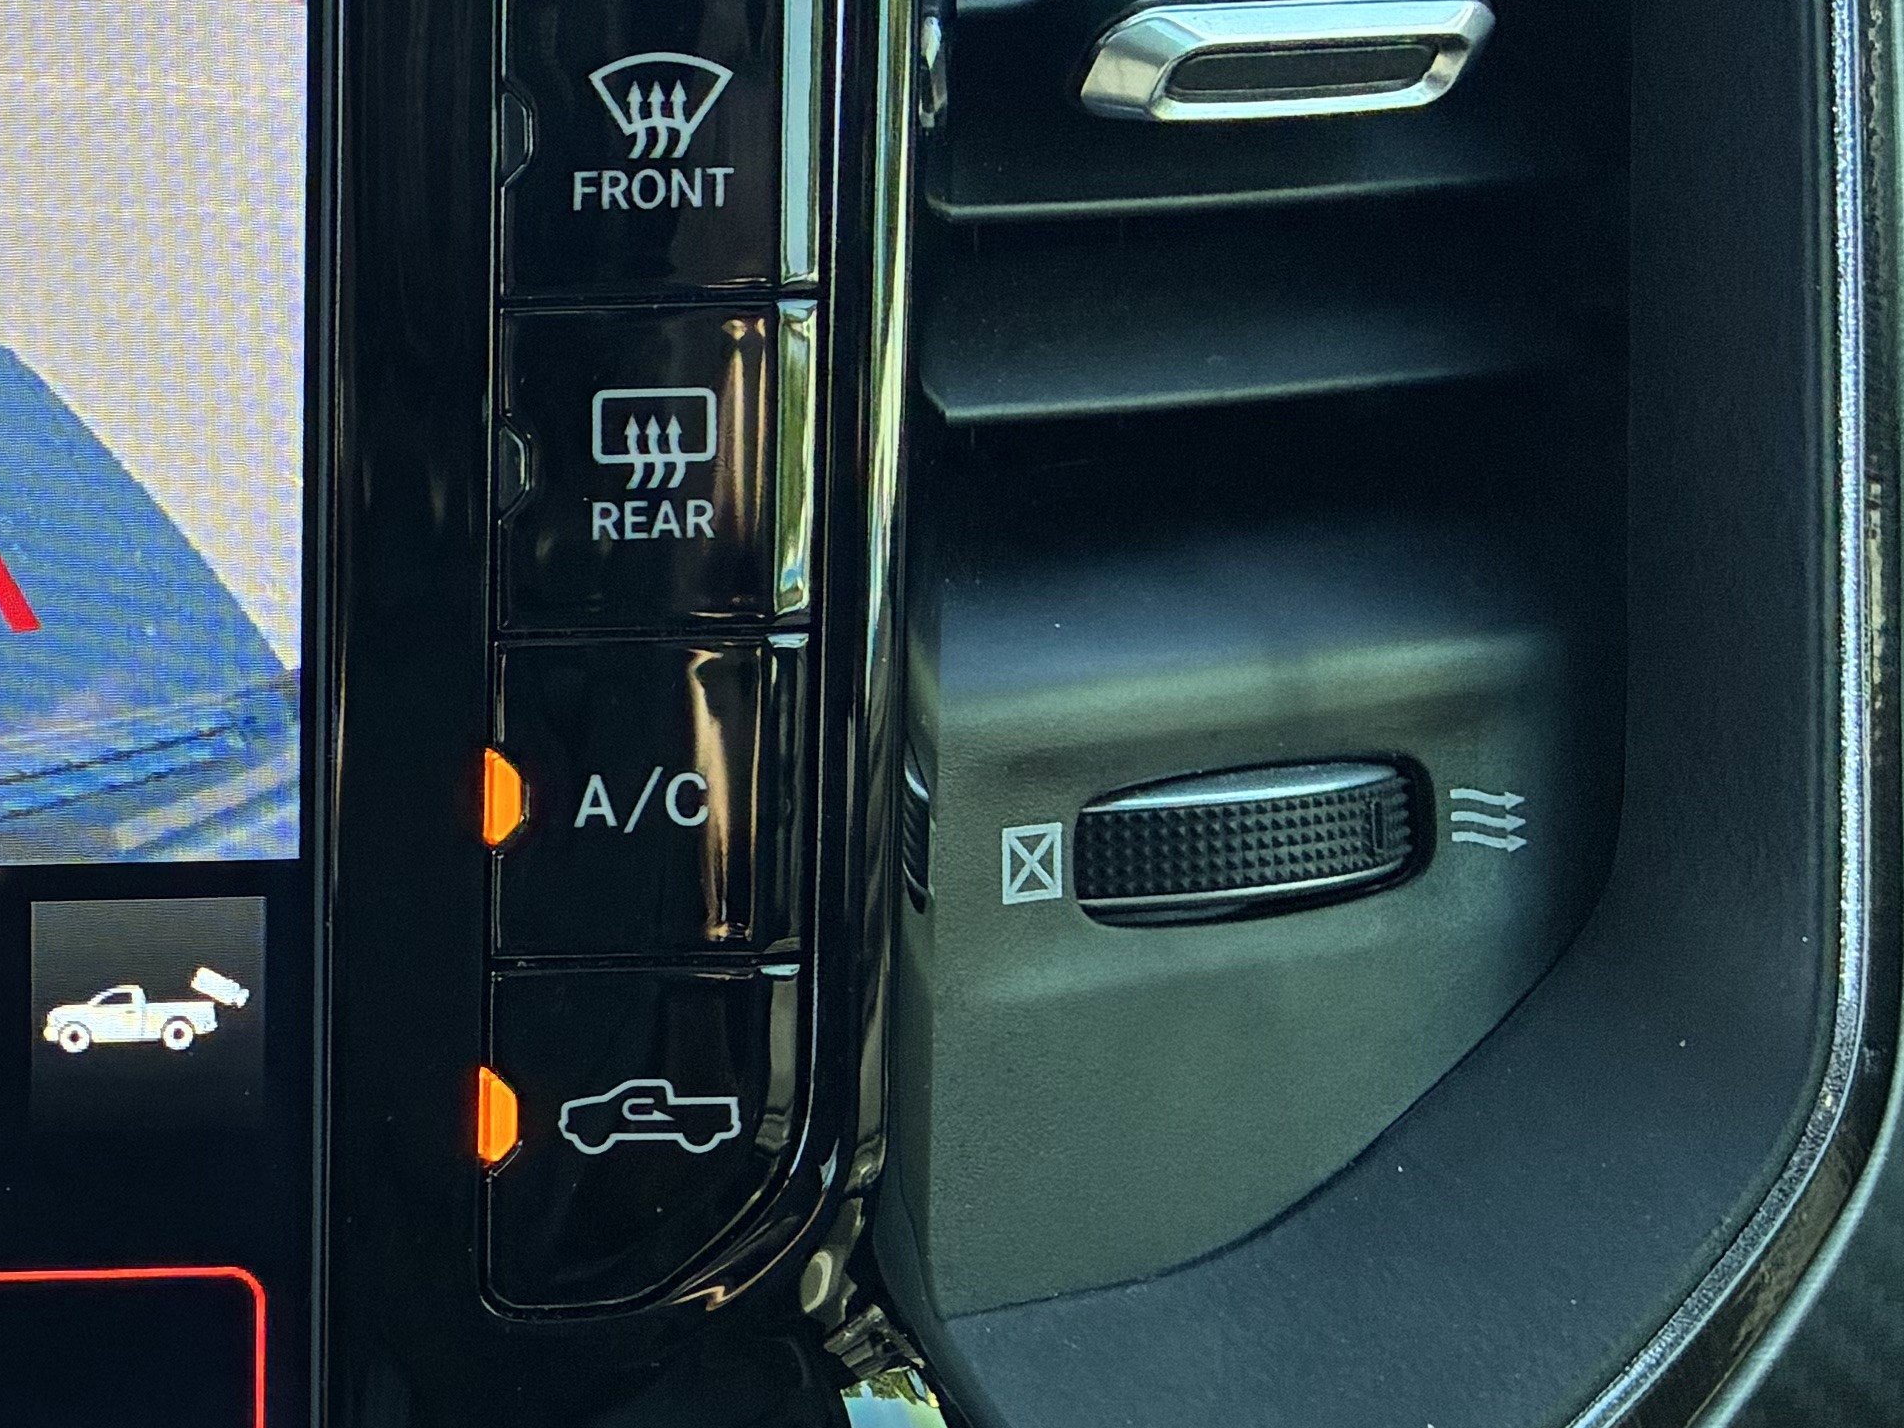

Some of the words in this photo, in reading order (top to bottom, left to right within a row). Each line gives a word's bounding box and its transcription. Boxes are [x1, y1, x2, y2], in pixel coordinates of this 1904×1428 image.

[573, 168, 734, 210] FRONT
[593, 500, 714, 540] REAR
[574, 767, 708, 833] A/C
